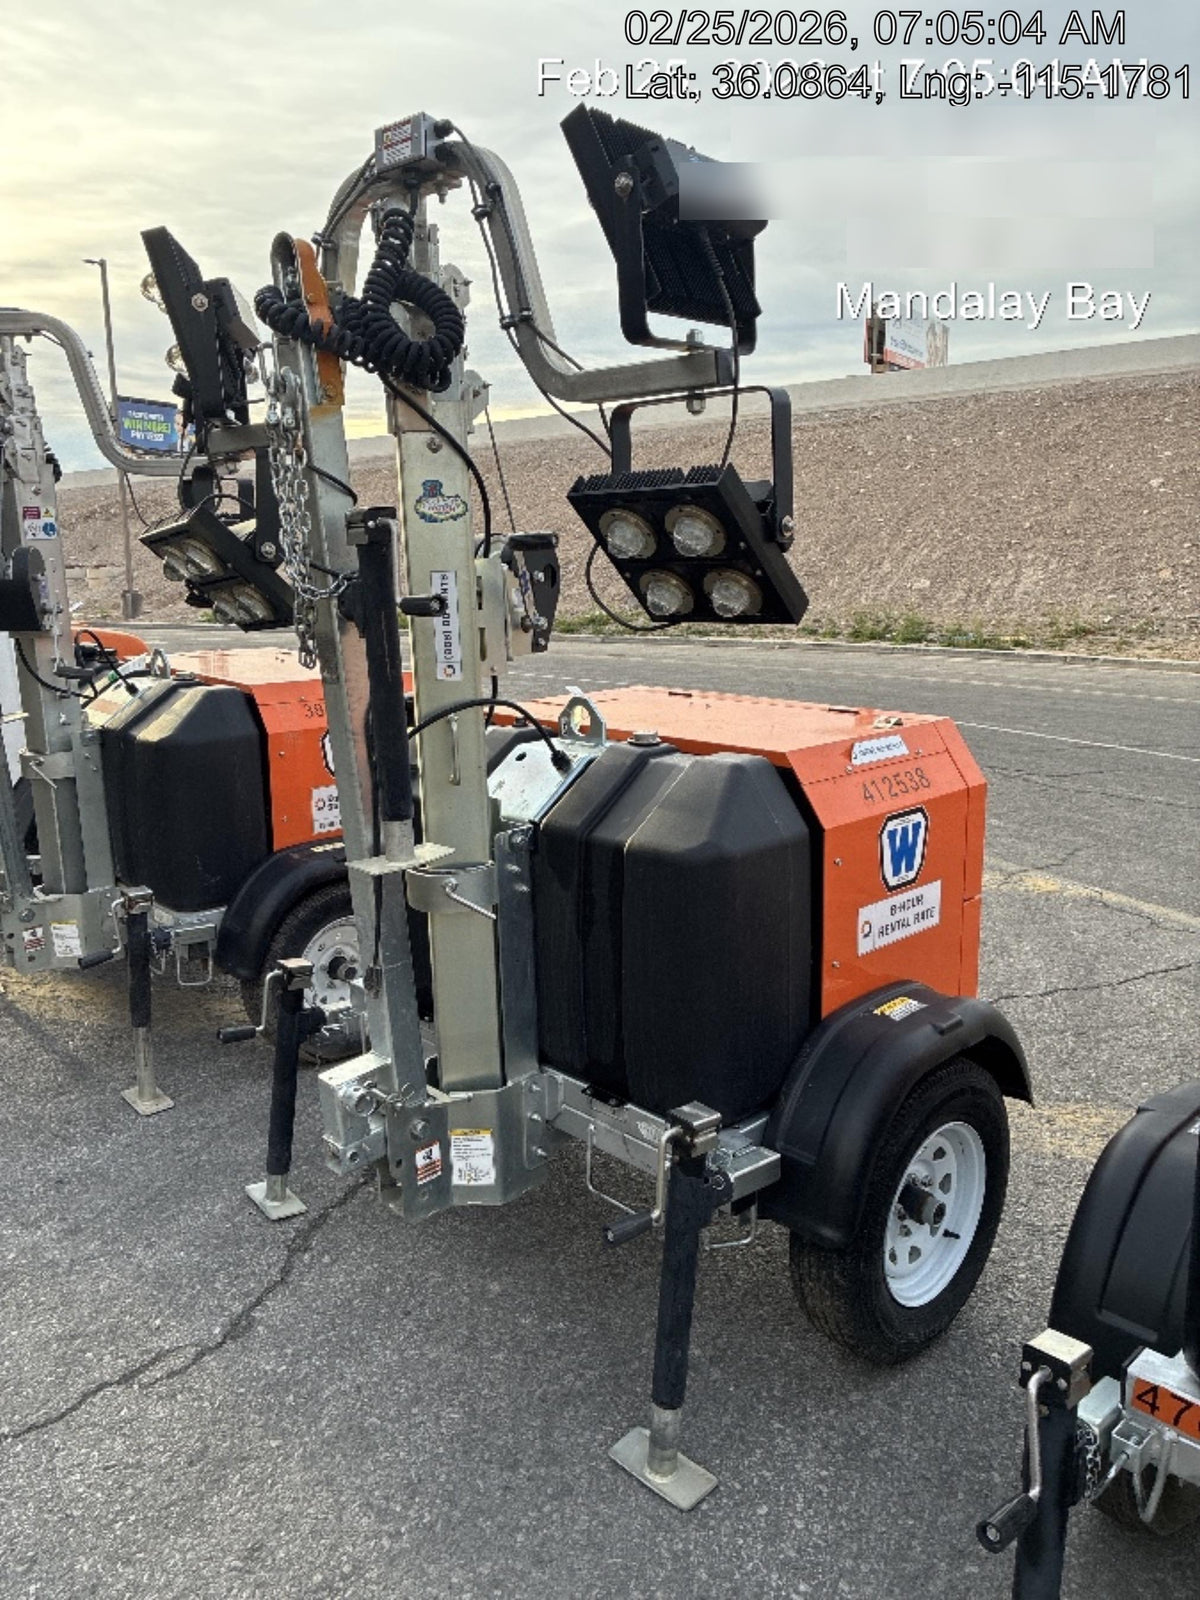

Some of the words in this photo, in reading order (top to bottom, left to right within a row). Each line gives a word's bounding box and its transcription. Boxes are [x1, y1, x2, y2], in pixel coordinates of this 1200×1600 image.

[863, 767, 931, 803] 412538
[887, 820, 921, 877] W
[878, 917, 911, 939] RENTAL
